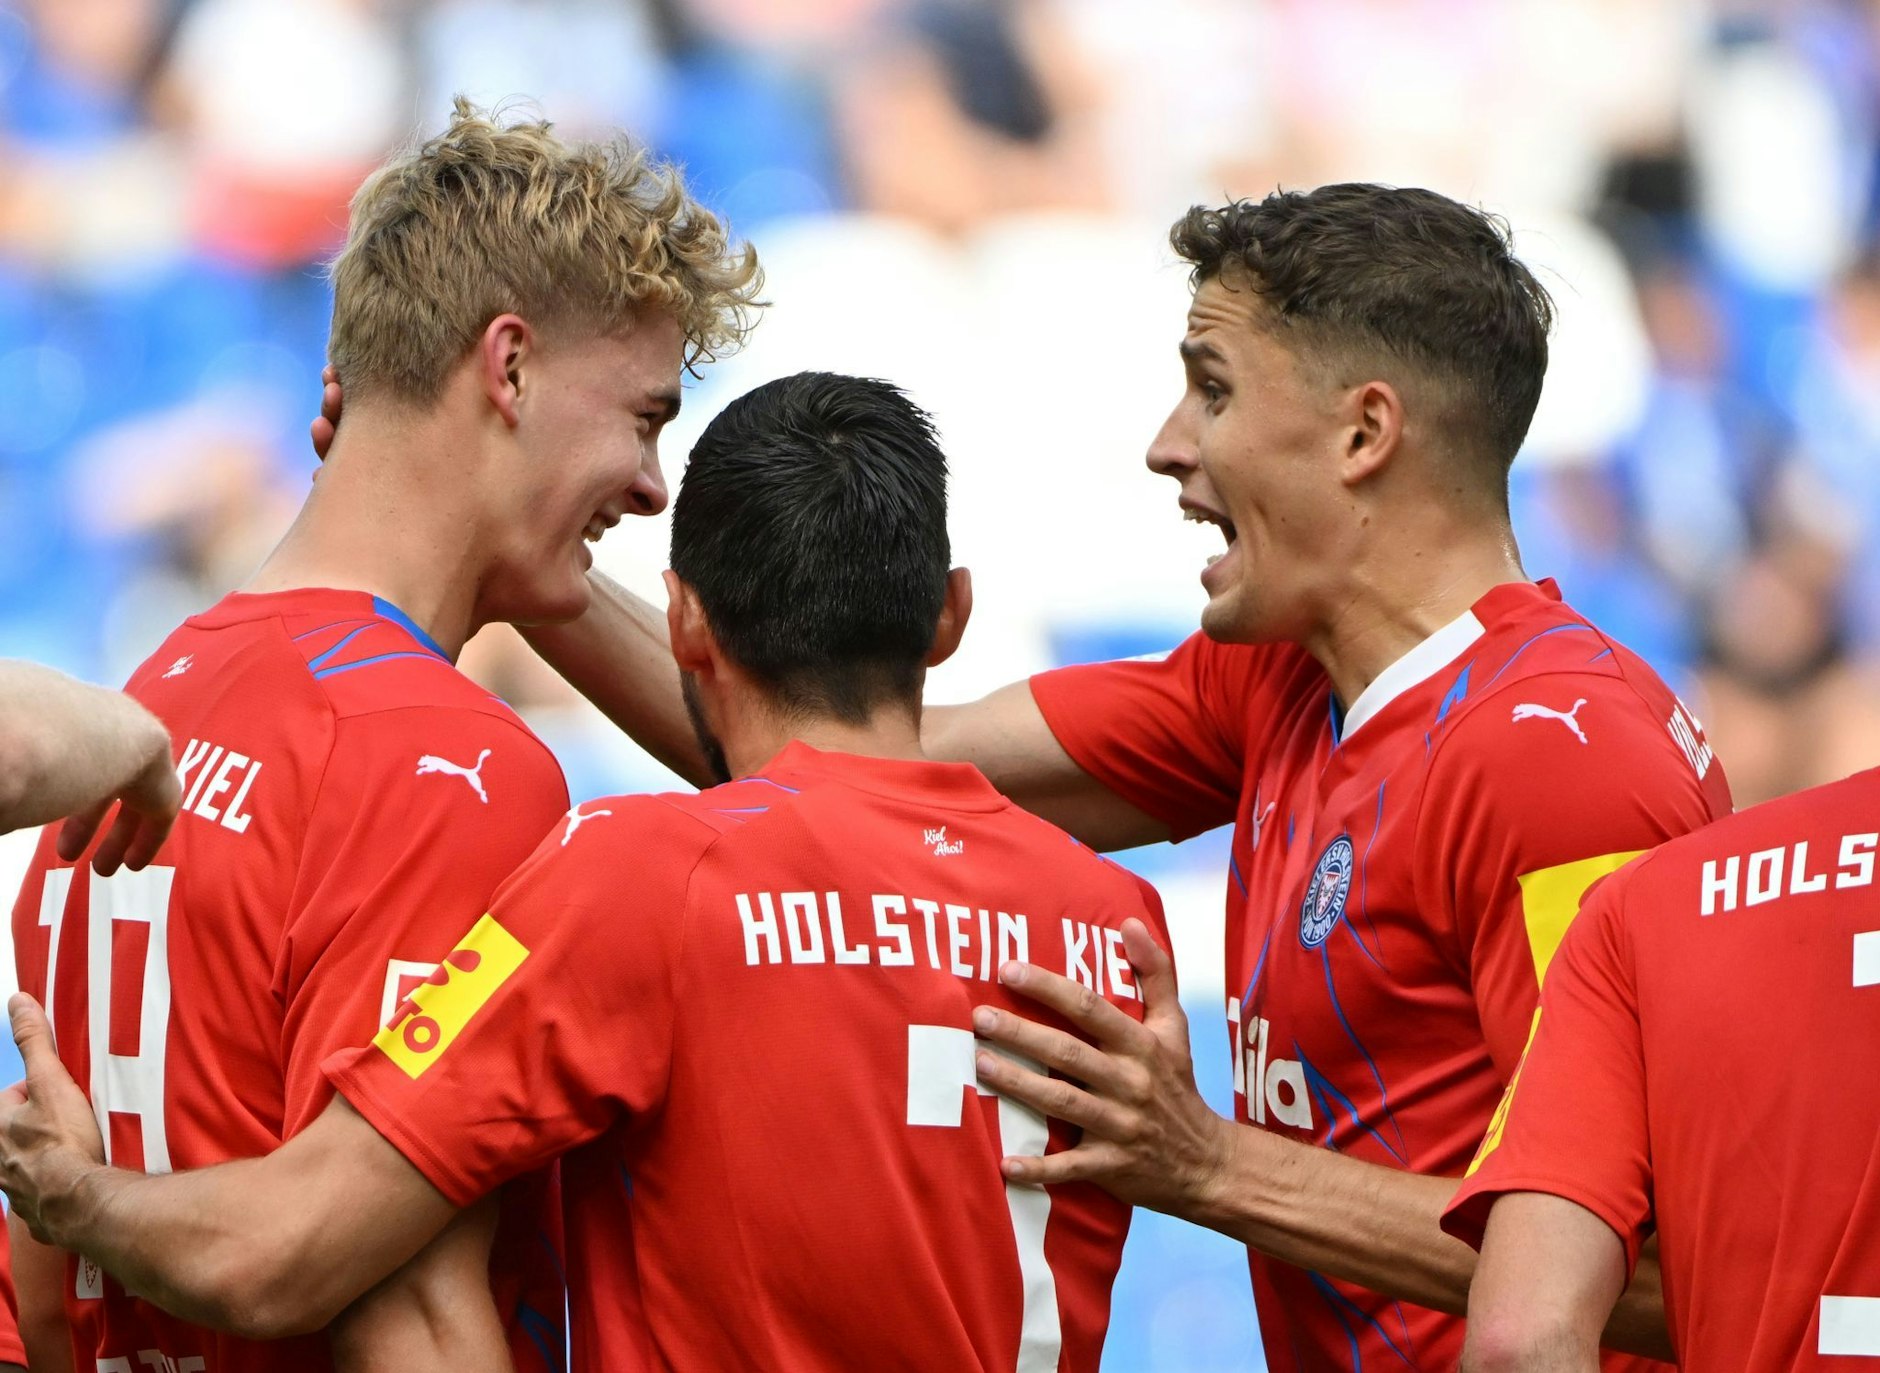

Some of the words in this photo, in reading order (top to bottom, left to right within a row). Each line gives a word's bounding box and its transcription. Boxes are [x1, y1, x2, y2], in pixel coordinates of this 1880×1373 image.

[923, 825, 946, 845] Kiel
[933, 840, 963, 856] Ahoi!
[736, 890, 1030, 984] HOLSTEIN
[1062, 918, 1144, 1003] KIE
[38, 861, 176, 1298] 18
[906, 1024, 1062, 1373] 7
